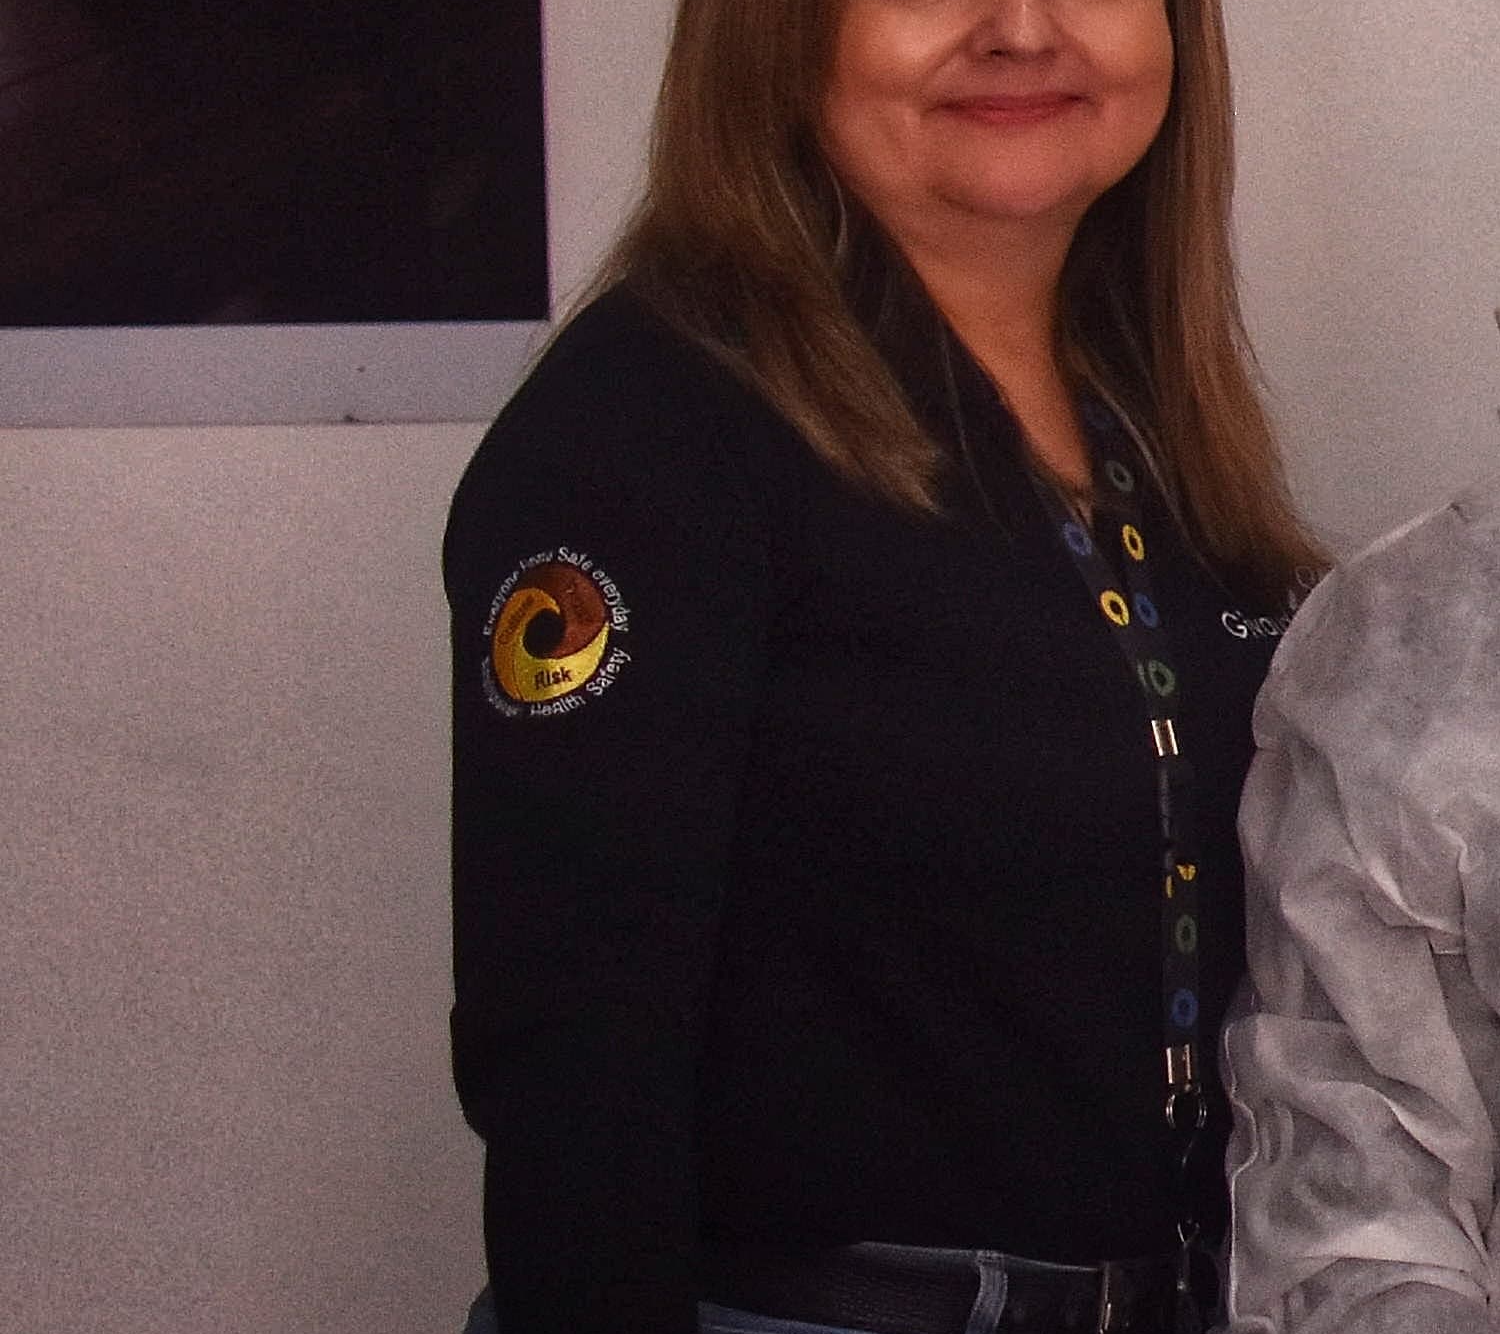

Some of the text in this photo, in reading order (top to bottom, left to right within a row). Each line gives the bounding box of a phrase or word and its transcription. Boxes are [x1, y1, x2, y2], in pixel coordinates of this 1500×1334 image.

[557, 546, 594, 571] Safe
[592, 569, 633, 633] everyday
[586, 646, 632, 696] Safety
